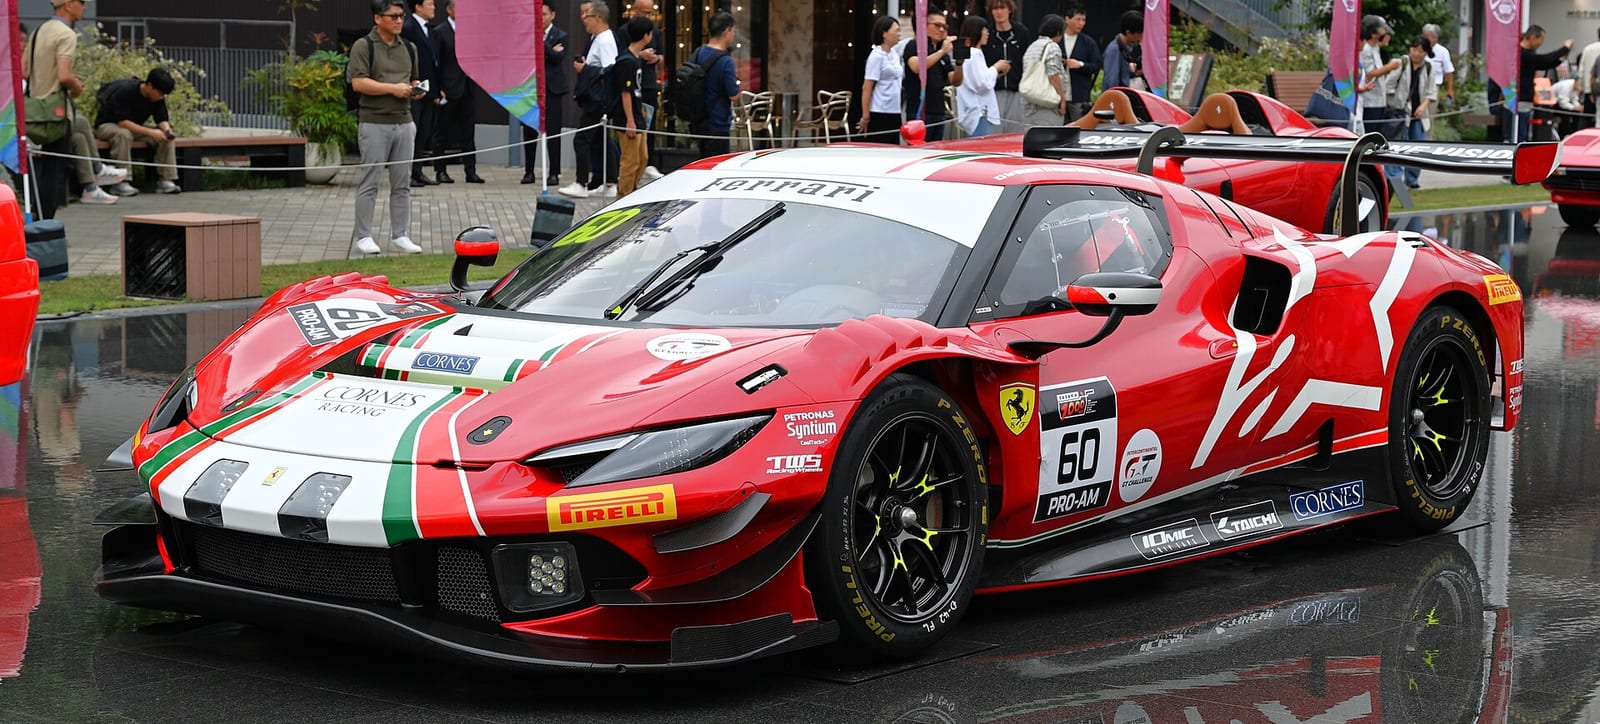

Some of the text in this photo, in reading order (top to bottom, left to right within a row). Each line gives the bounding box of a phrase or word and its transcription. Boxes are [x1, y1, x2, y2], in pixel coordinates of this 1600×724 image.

[1079, 135, 1140, 145] ONE
[1431, 146, 1513, 159] VISIO
[694, 176, 882, 203] Ferrari
[1490, 279, 1518, 299] PIRELLI
[295, 308, 332, 341] PRO-AM
[1440, 315, 1487, 367] P ZERO
[416, 353, 475, 372] CORNES
[322, 385, 426, 409] CORNES
[317, 402, 386, 418] RACING
[783, 410, 835, 421] PETRONAS
[1060, 399, 1086, 421] 1000
[786, 420, 837, 440] Syntium
[937, 397, 987, 484] P ZERO
[766, 454, 822, 469] TWS
[1057, 427, 1100, 485] 60
[560, 492, 665, 525] PIRELLI
[1047, 487, 1099, 516] PRO-AM
[1294, 484, 1360, 518] CORNES
[1405, 479, 1455, 520] PIRELLI
[1230, 512, 1277, 533] TAICHI
[841, 565, 896, 643] PIRELLI
[922, 600, 958, 633] FL D-42
